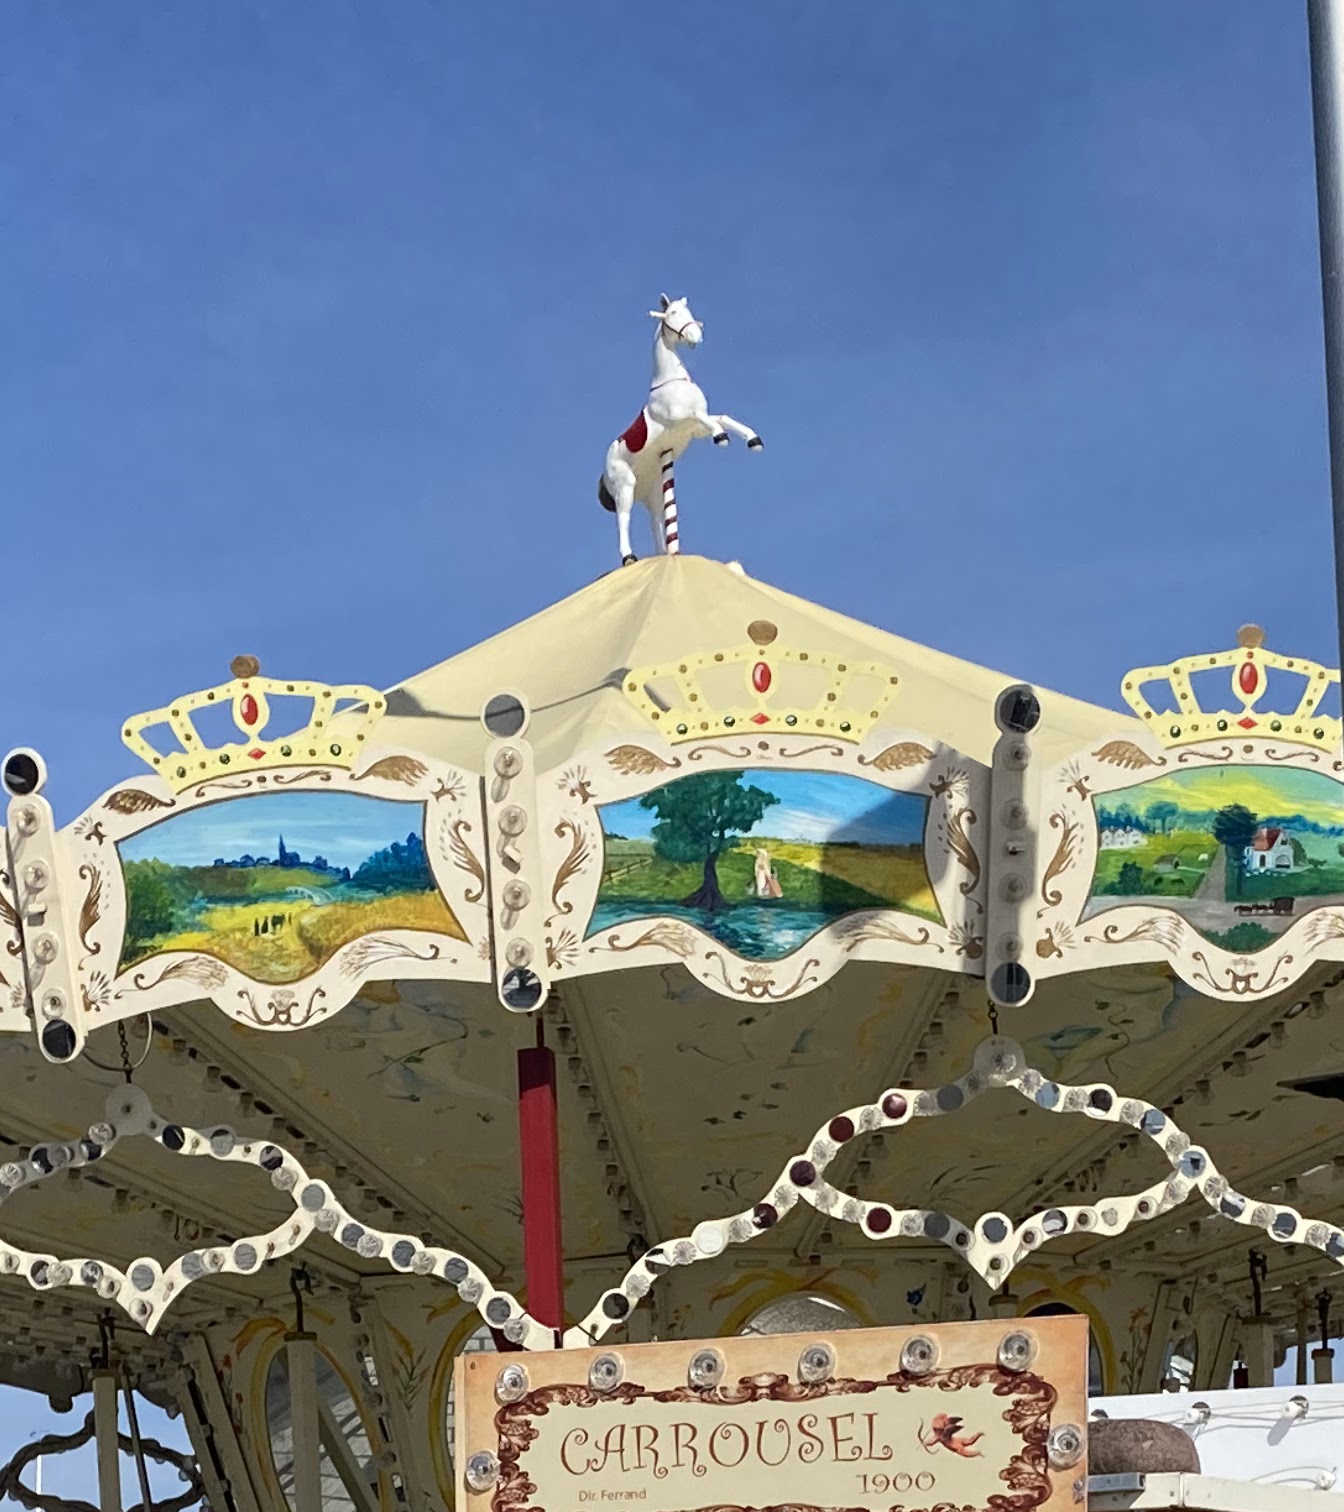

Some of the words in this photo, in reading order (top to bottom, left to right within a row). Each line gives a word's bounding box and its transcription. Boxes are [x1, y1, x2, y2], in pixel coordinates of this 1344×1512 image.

[559, 1412, 893, 1479] CARROUSEL
[856, 1471, 936, 1494] 1900
[600, 1488, 647, 1501] Ferrand
